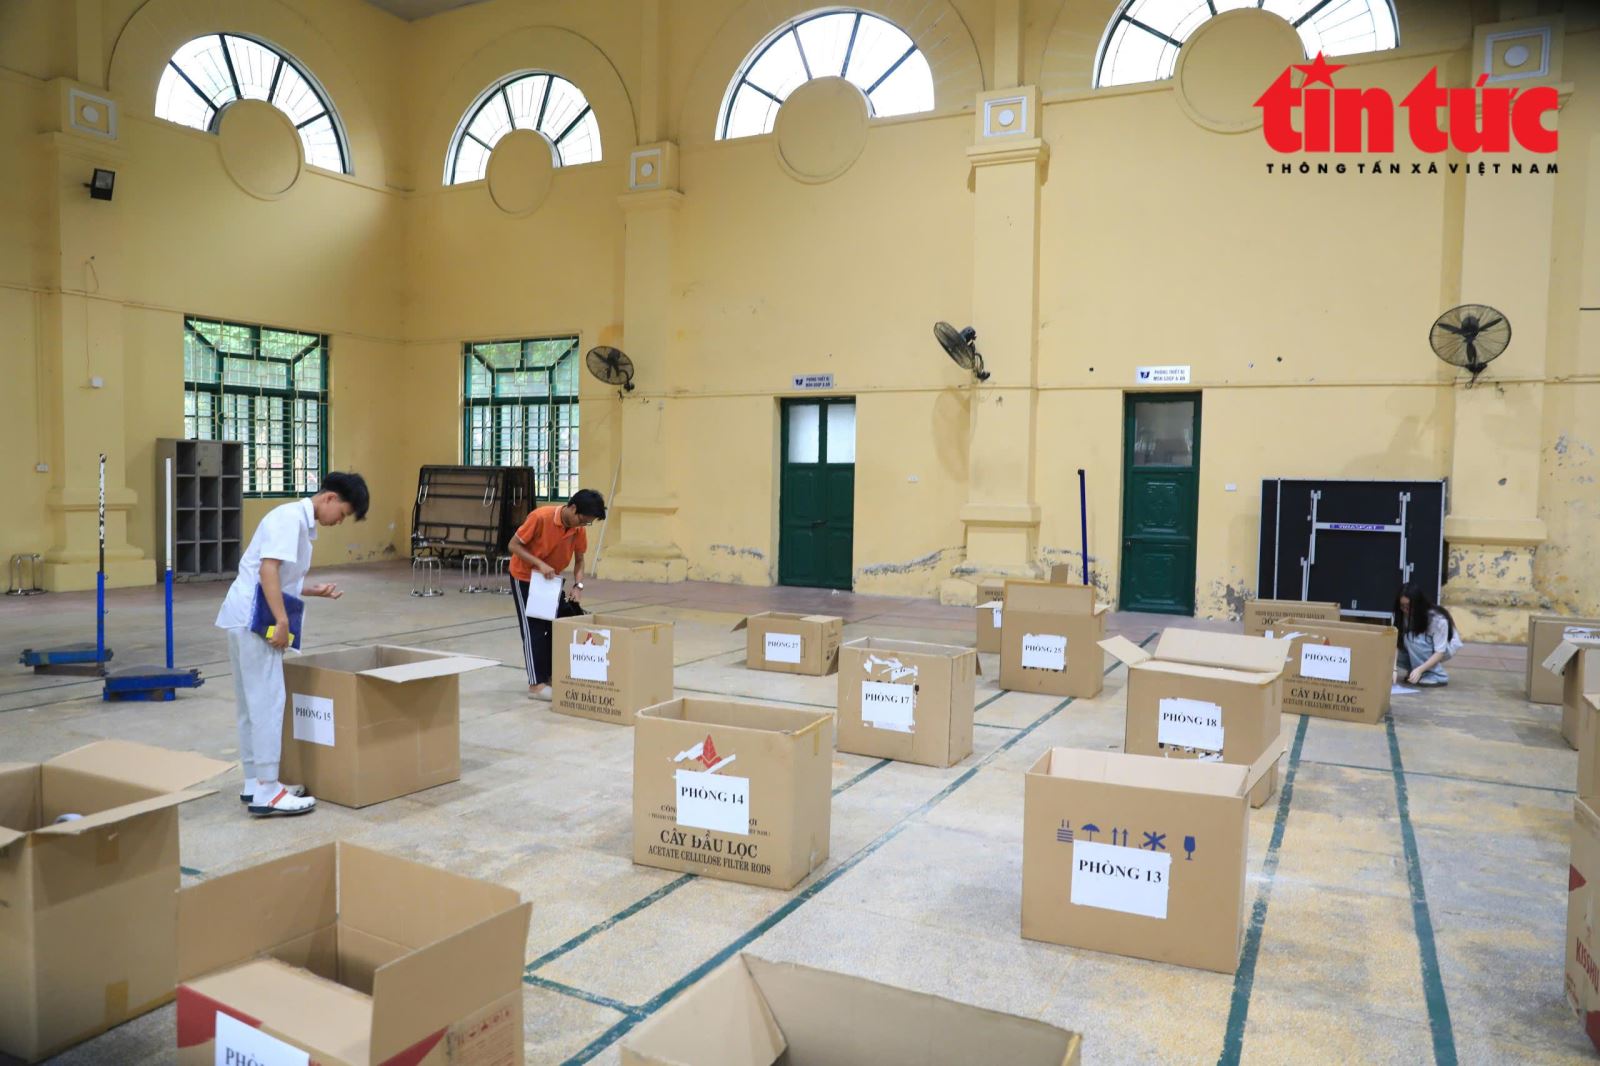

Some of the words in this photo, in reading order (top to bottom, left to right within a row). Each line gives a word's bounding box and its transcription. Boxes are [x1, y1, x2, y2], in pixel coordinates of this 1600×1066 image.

[1025, 643, 1052, 653] PHÒNG
[1053, 646, 1062, 654] 25
[1304, 651, 1336, 663] PHÒNG
[1338, 656, 1348, 664] 26
[865, 692, 898, 703] PHÒNG
[900, 696, 910, 704] 17
[1291, 687, 1310, 698] CÂY
[1336, 694, 1358, 705] LỌC
[295, 706, 322, 720] PHÒNG
[323, 712, 331, 721] 15
[1163, 711, 1202, 725] PHÒNG
[1206, 718, 1217, 727] 18
[681, 783, 728, 803] PHÒNG
[731, 793, 745, 805] 14
[660, 803, 677, 813] CÔN
[660, 828, 687, 846] CÂY
[691, 829, 724, 853] ĐẦU
[727, 840, 758, 860] LỌC
[648, 844, 680, 860] ACETATE
[680, 850, 722, 867] CELLULOSE
[723, 857, 749, 871] FILTER
[751, 862, 771, 875] RODS
[1079, 859, 1140, 881] PHÒNG
[1146, 870, 1162, 883] 13
[225, 1046, 265, 1066] PHÒ
